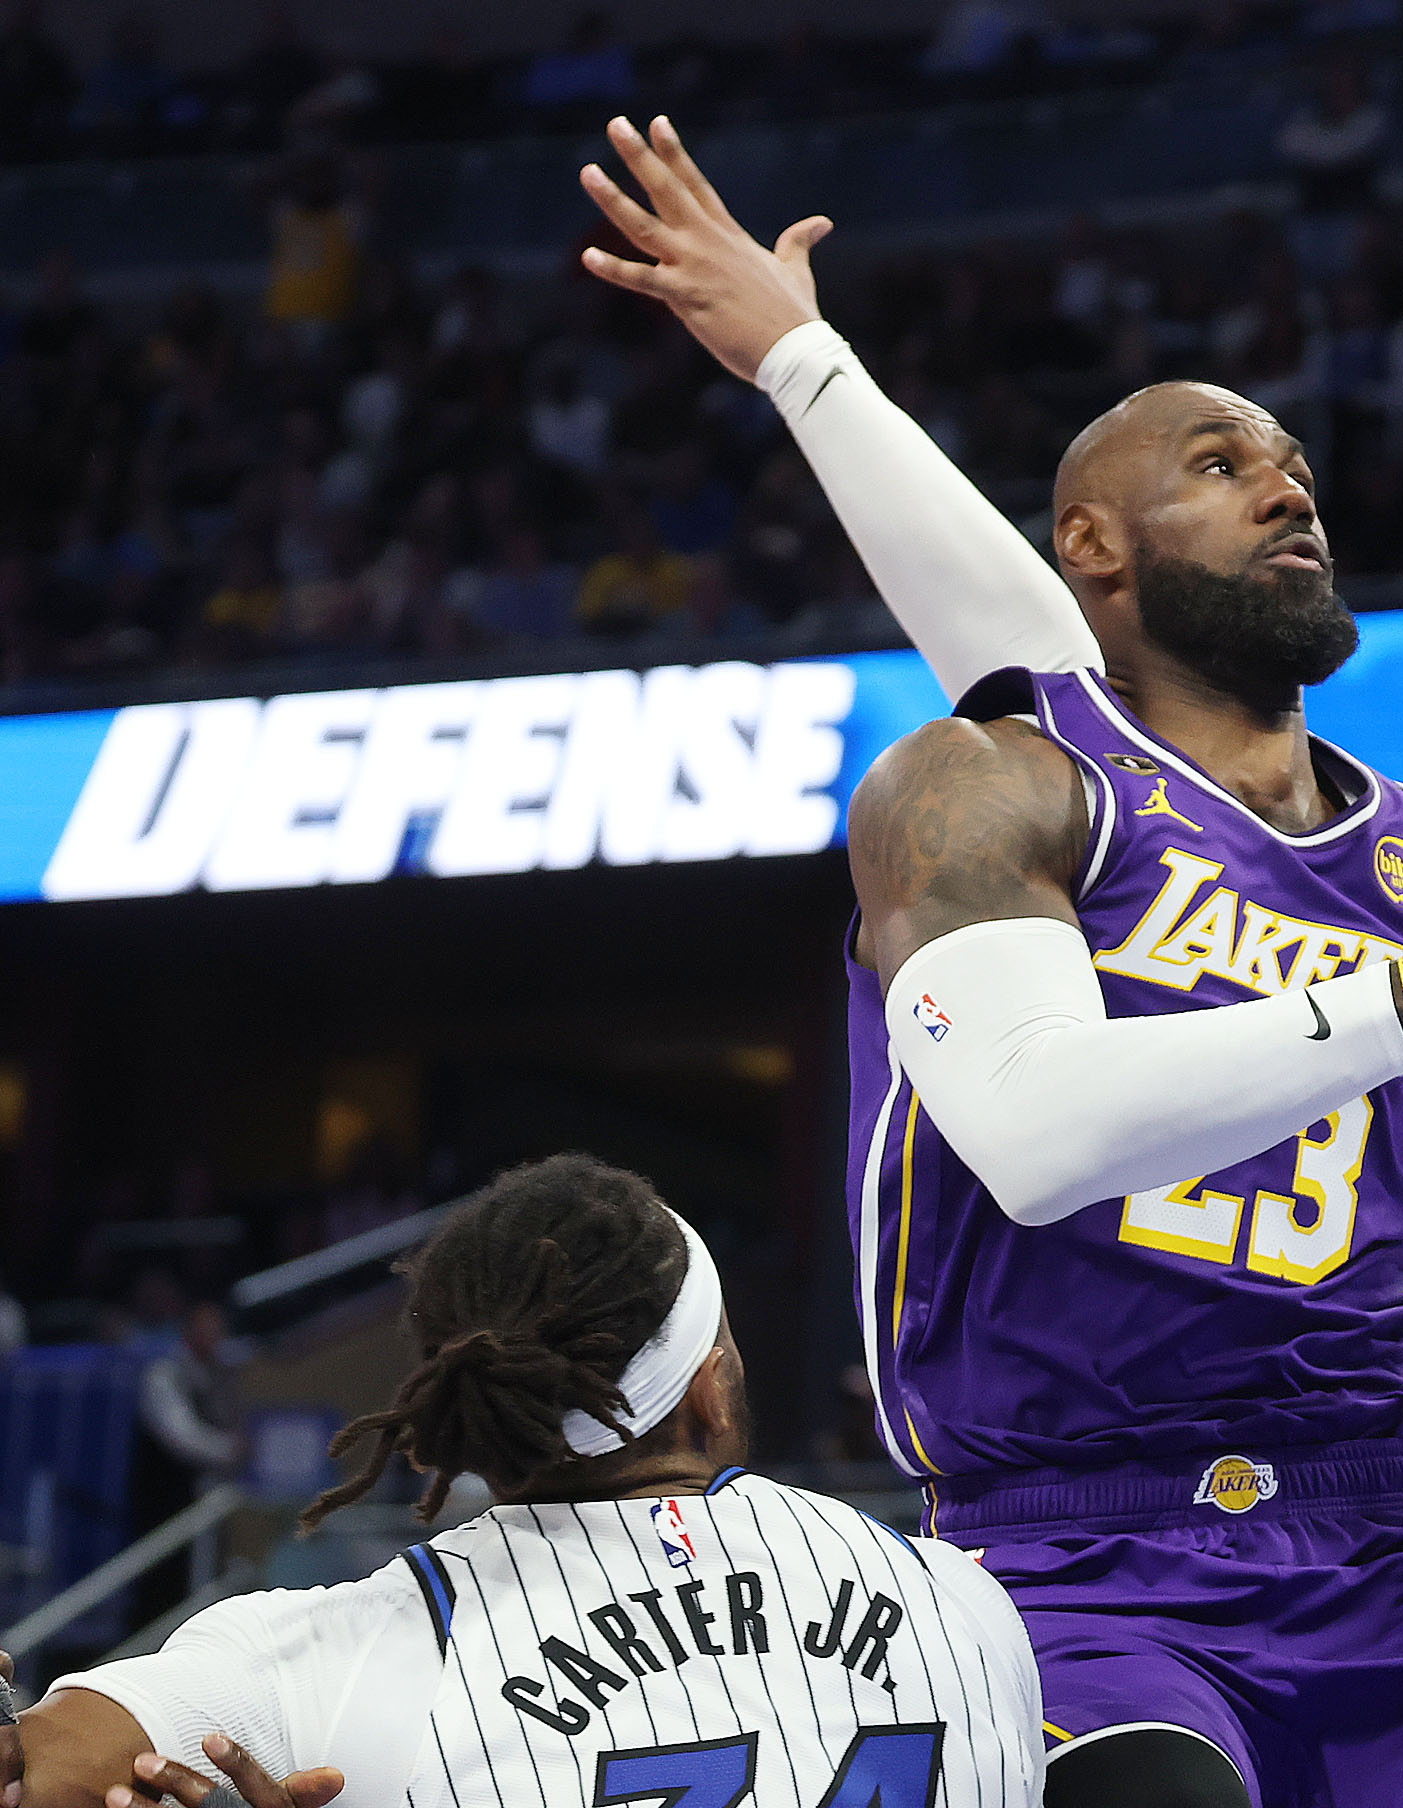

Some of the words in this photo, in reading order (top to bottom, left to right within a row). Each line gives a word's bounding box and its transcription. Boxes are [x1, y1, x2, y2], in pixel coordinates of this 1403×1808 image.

[42, 660, 856, 902] DEFENSE
[1197, 1469, 1274, 1500] LAKERS
[501, 1571, 770, 1736] CARTER
[804, 1580, 902, 1692] JR.
